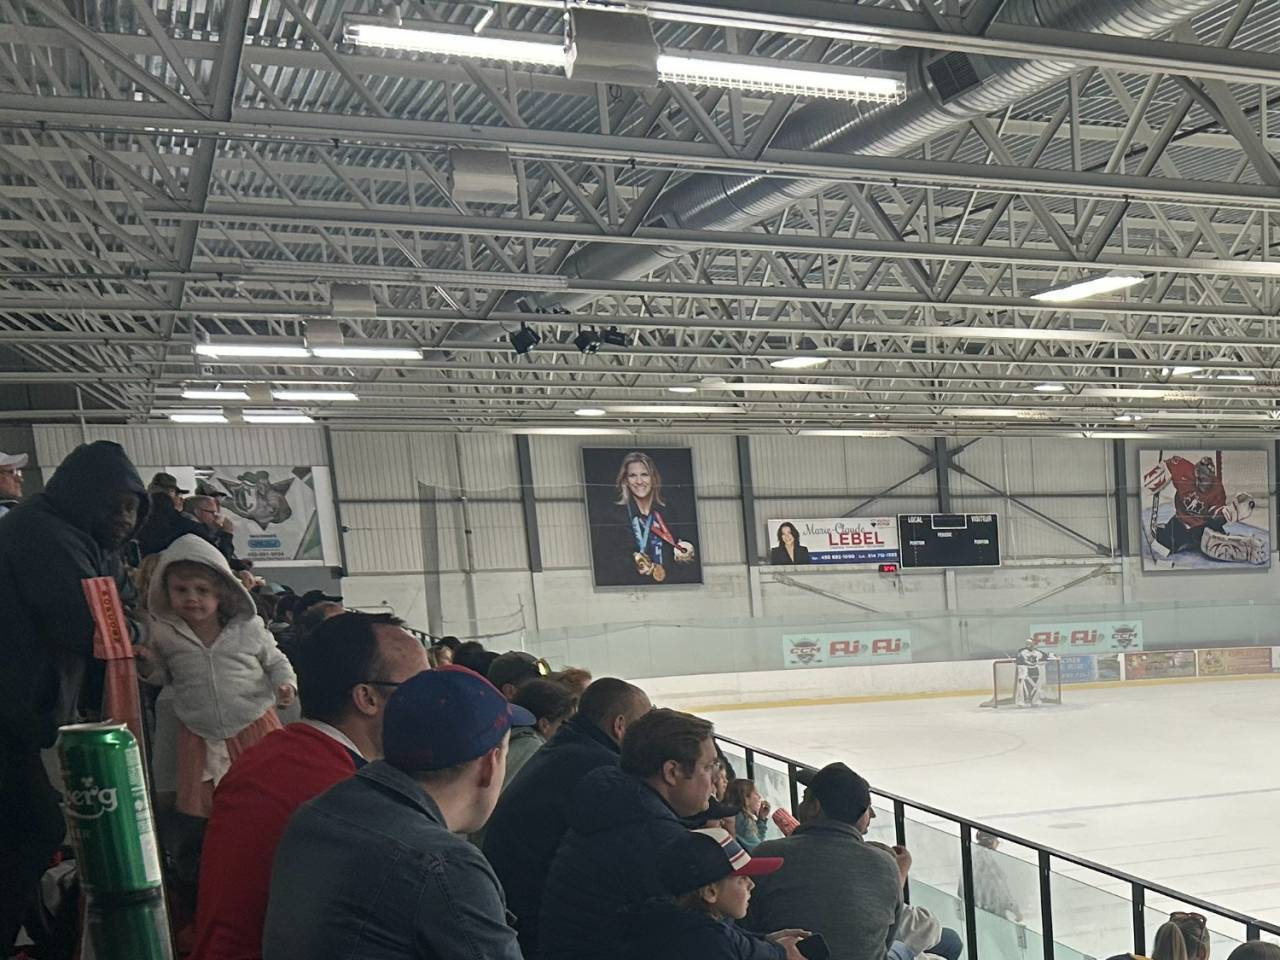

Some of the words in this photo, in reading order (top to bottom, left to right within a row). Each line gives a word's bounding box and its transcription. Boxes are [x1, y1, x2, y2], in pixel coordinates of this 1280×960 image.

[907, 515, 923, 524] LOCAL
[970, 515, 992, 523] VISITEUR
[828, 531, 885, 546] LEBEL
[1111, 632, 1138, 640] CCM
[790, 646, 821, 655] CCM
